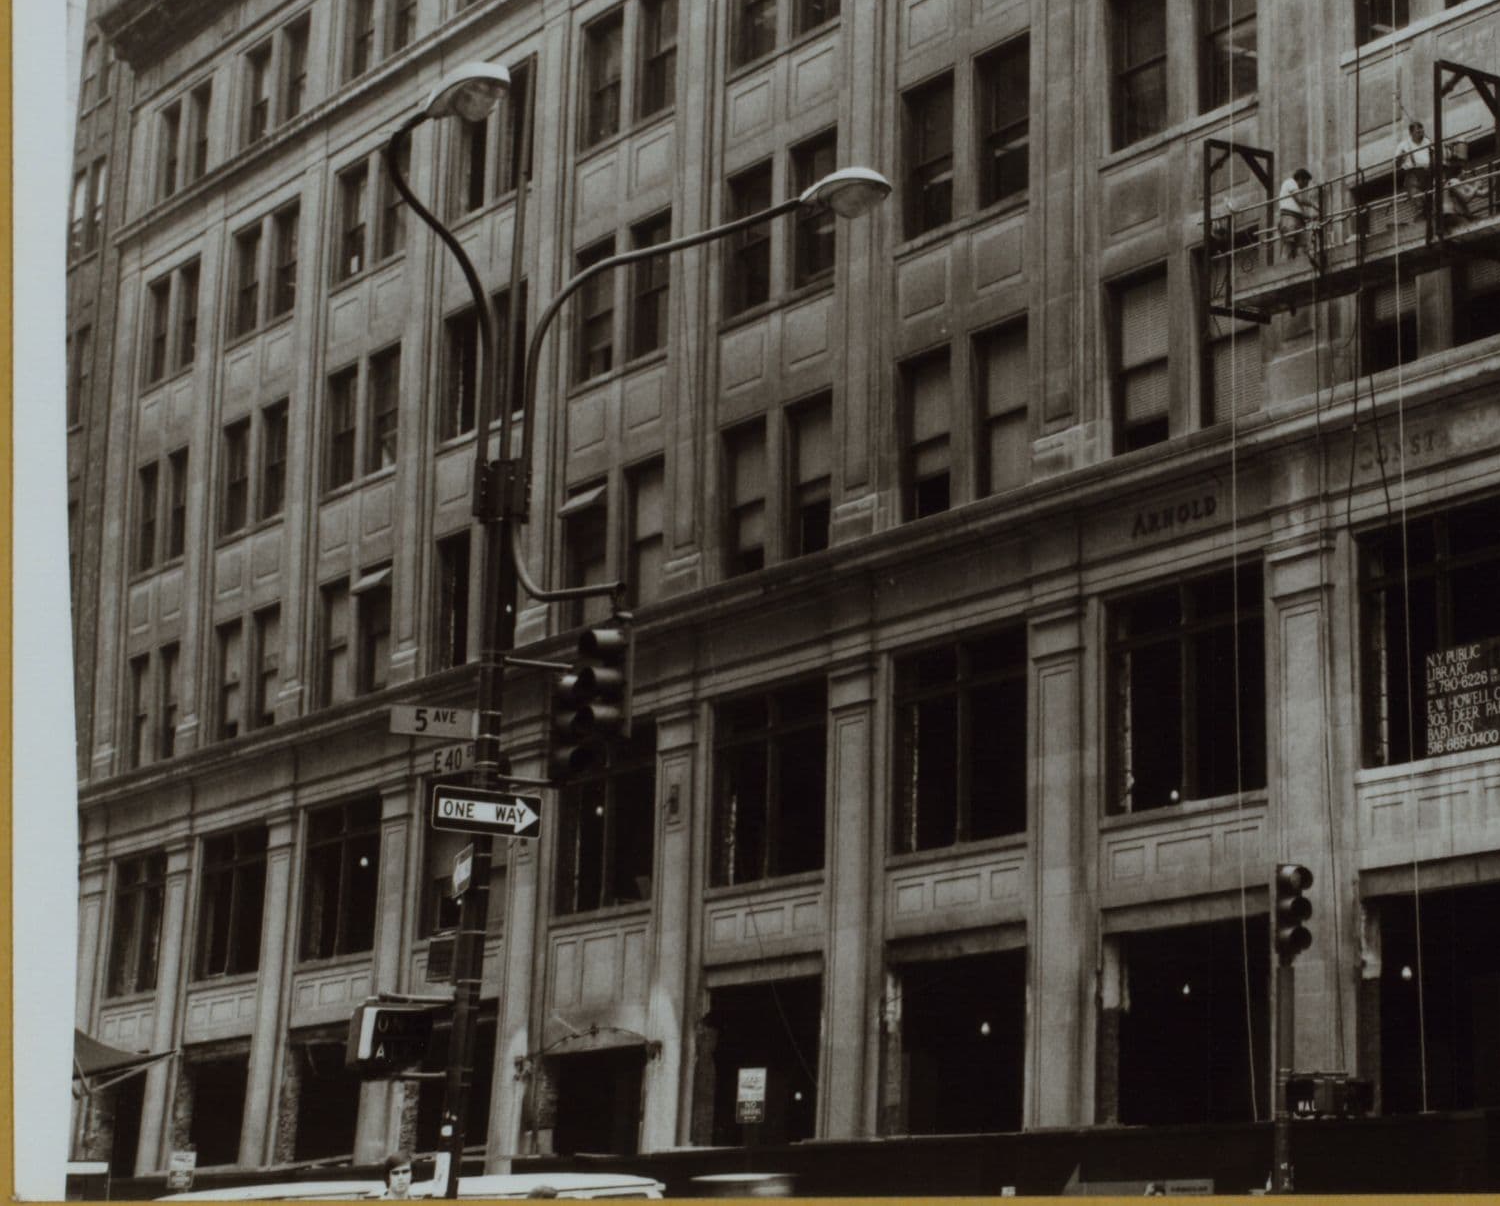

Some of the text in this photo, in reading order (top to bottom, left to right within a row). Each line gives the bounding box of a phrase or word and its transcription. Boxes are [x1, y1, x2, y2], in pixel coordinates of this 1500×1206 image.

[1131, 496, 1218, 539] ARNOLD
[1446, 644, 1480, 664] PUBLIC
[1427, 661, 1469, 682] LIBRARY
[1447, 689, 1491, 711] HOWELL
[415, 709, 457, 732] 5 AVE
[1452, 705, 1480, 723] DEER
[1427, 720, 1474, 742] BABYLON
[433, 752, 442, 774] E
[444, 747, 462, 771] 40
[443, 801, 526, 823] ONE WAY
